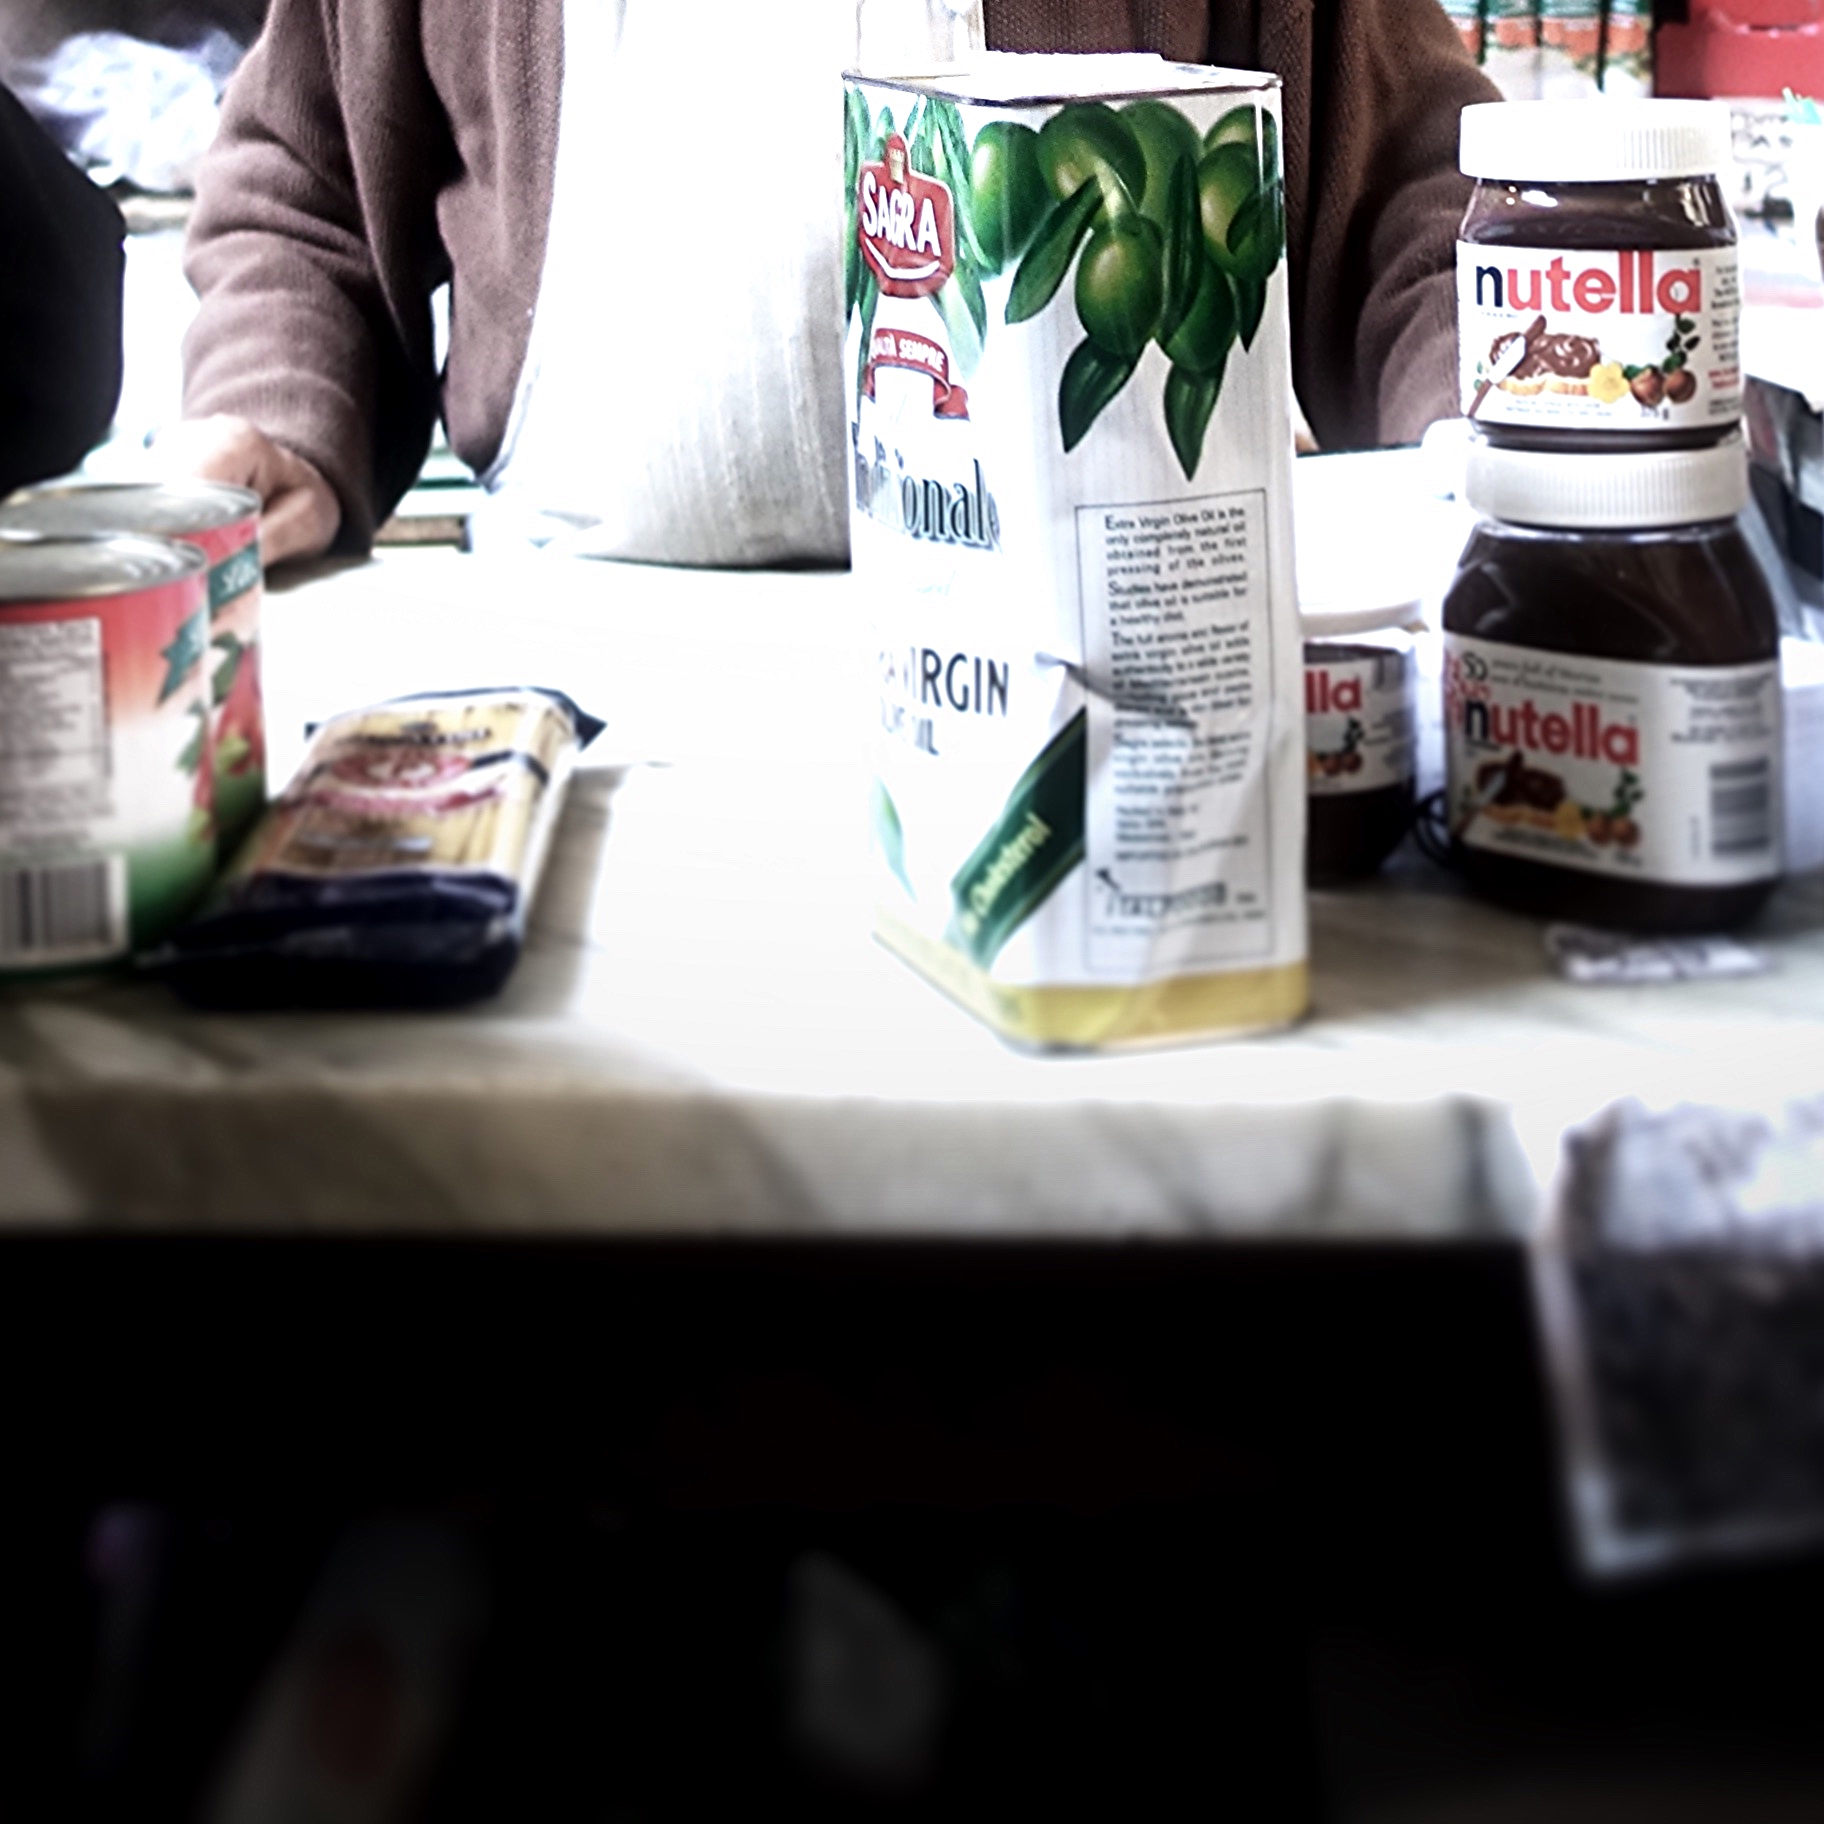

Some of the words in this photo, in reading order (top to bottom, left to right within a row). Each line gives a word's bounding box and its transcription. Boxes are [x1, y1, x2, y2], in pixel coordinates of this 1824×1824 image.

[863, 169, 942, 258] SAGRA
[1475, 249, 1702, 315] nutella
[898, 337, 945, 373] SEMPRE
[1105, 514, 1135, 530] Extra
[1138, 516, 1171, 530] Virgin
[1173, 513, 1198, 525] Olive
[1200, 509, 1215, 521] Oil
[1228, 507, 1245, 517] the
[1105, 534, 1128, 546] only
[1233, 520, 1246, 532] oil
[1106, 545, 1161, 560] obtained
[1167, 544, 1194, 555] from
[1199, 540, 1218, 551] the
[1224, 536, 1246, 548] first
[1107, 563, 1161, 577] pressing
[1168, 558, 1180, 571] of
[1186, 557, 1205, 569] the
[1108, 580, 1152, 596] Studies
[1154, 580, 1178, 592] have
[1108, 600, 1131, 610] that
[1134, 597, 1161, 609] olive
[1163, 595, 1177, 607] oil
[1111, 630, 1134, 646] The
[1464, 699, 1640, 766] nutella
